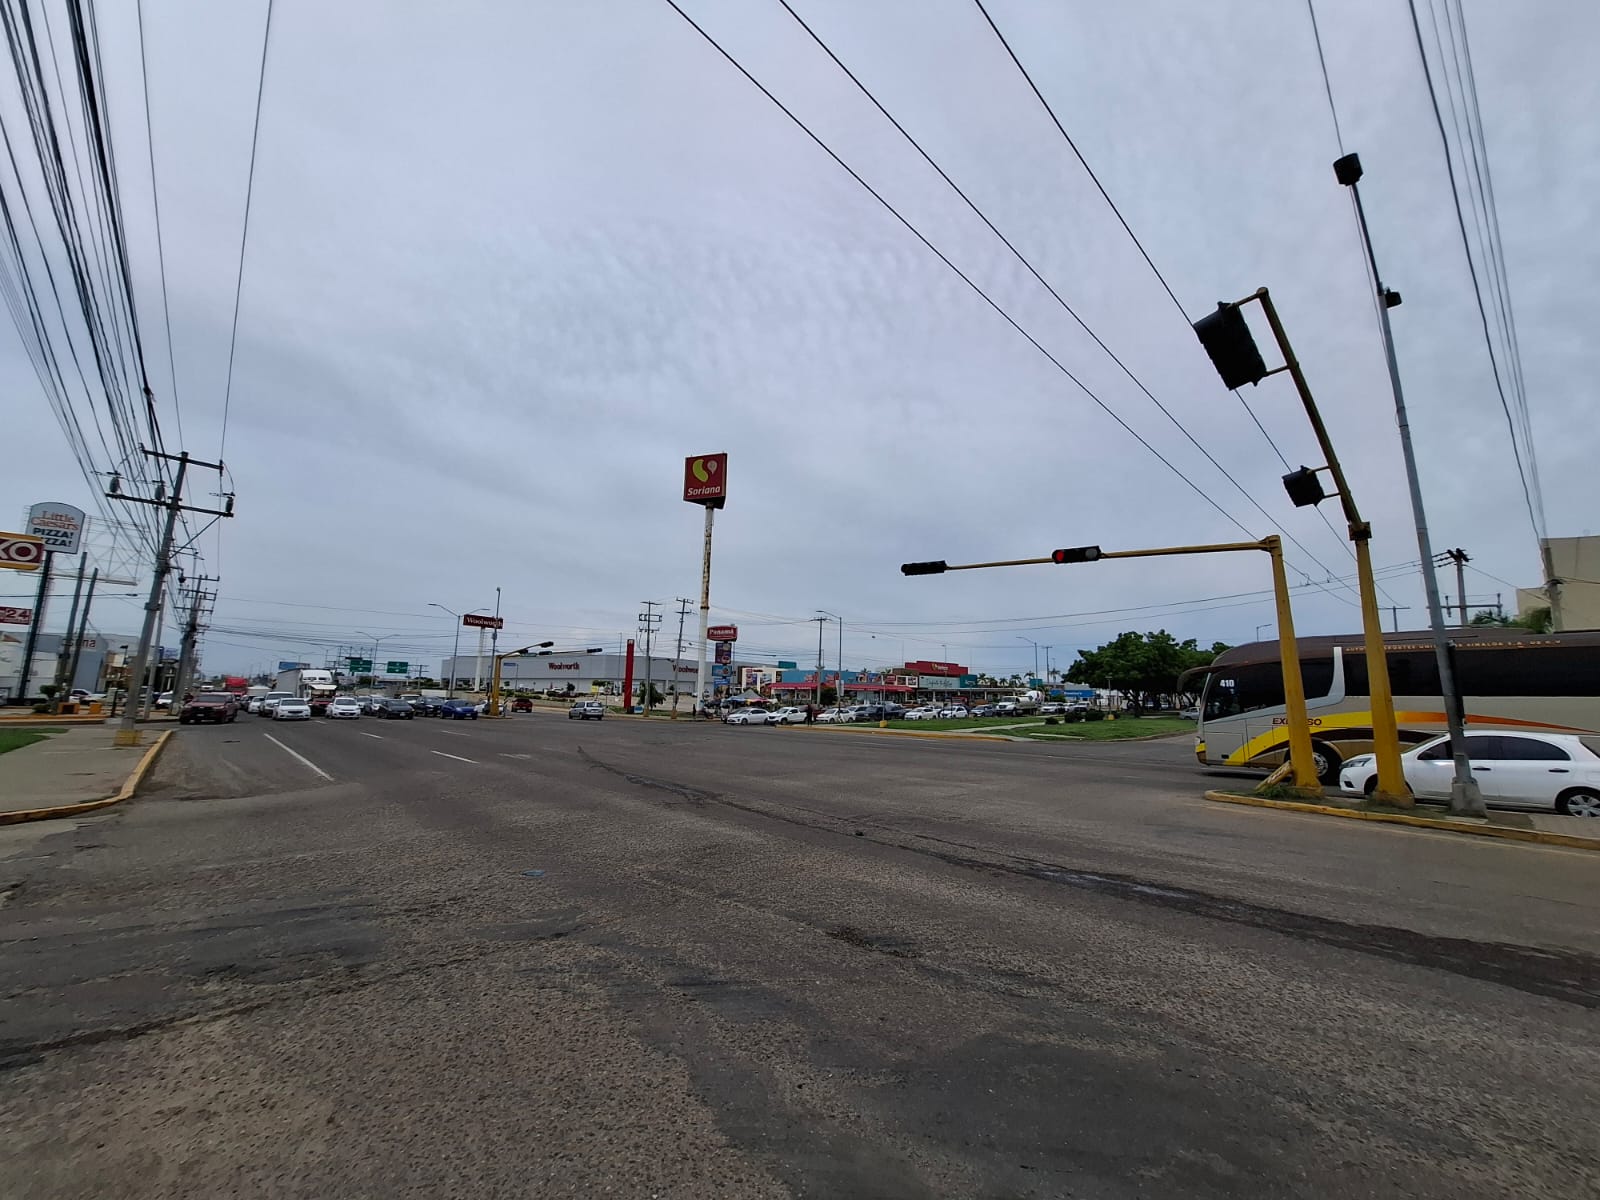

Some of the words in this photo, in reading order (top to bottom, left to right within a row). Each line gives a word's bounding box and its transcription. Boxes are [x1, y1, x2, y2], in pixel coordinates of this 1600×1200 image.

[687, 485, 721, 496] Soriana
[41, 510, 74, 521] Little
[31, 517, 80, 531] Caesars
[33, 527, 74, 539] PIZZA!
[466, 616, 503, 627] Woolwoh
[1219, 679, 1235, 688] 410
[1272, 717, 1322, 726] EXSO
